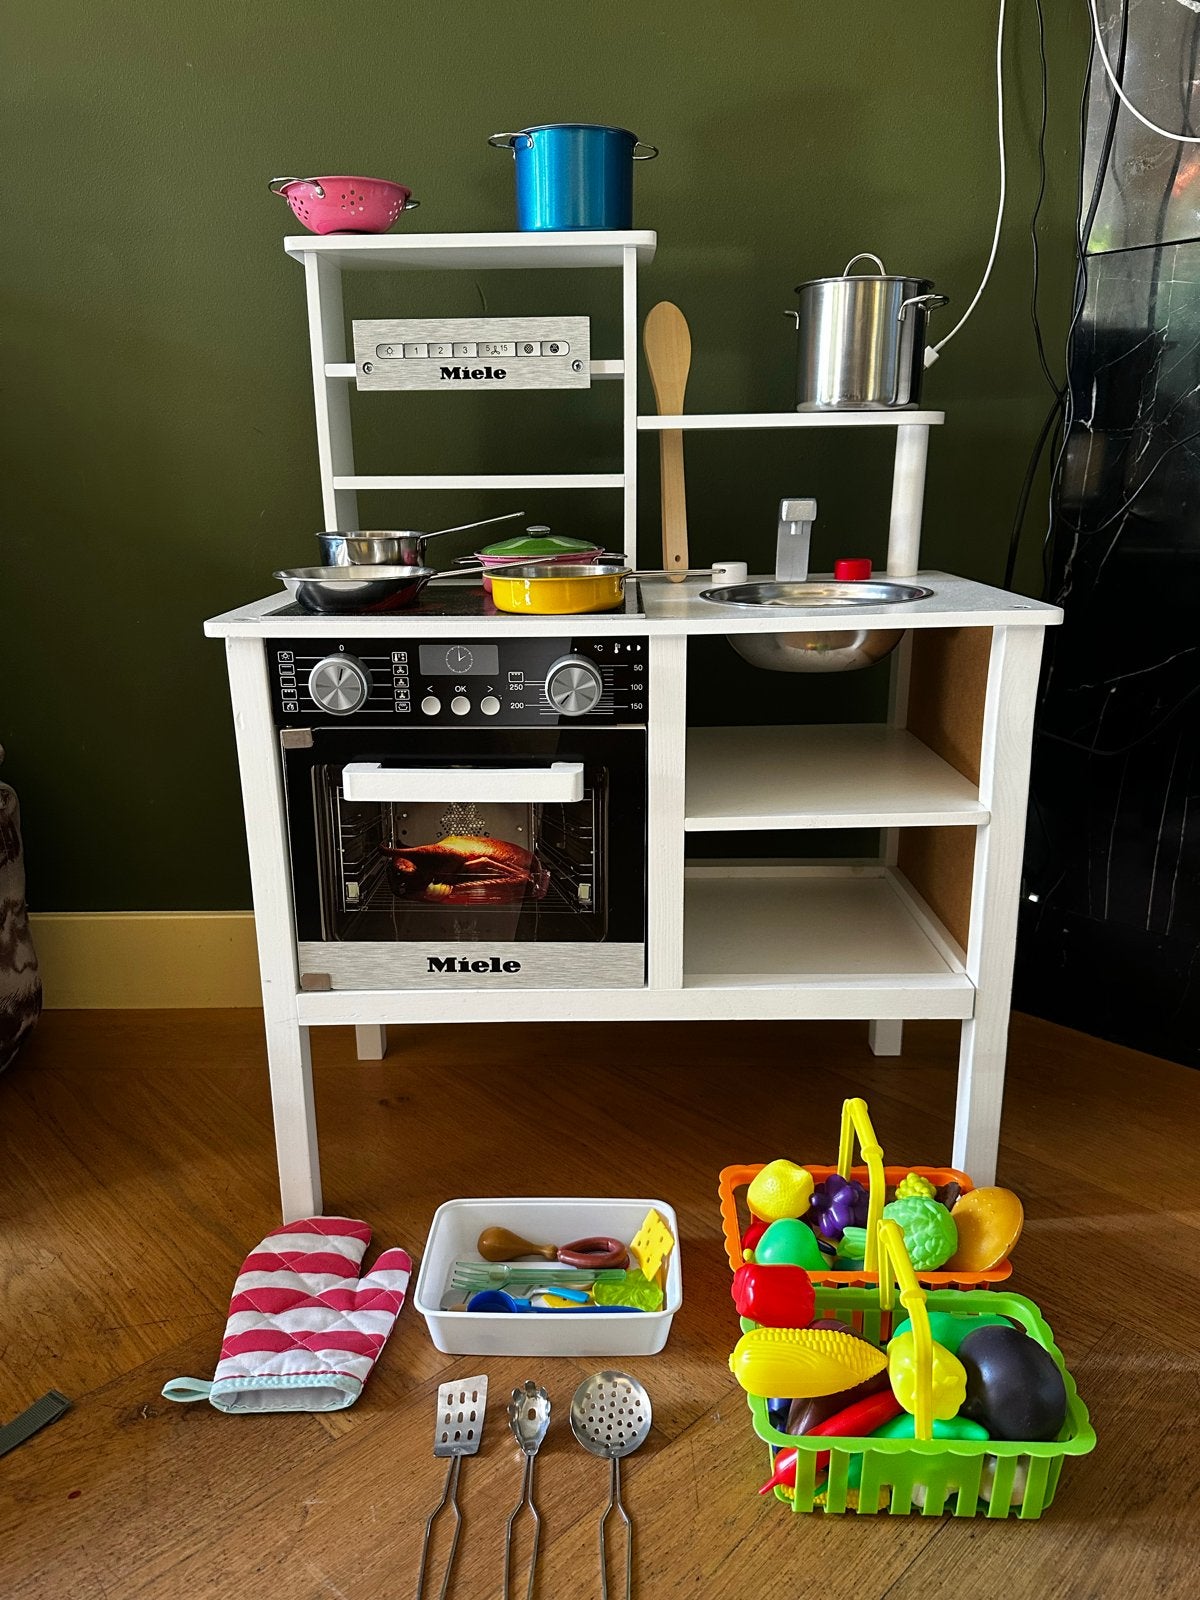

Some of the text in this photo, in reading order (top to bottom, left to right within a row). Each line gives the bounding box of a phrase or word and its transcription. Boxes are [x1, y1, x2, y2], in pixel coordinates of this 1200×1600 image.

[414, 347, 419, 355] 1
[438, 346, 444, 355] 2
[462, 346, 468, 354] 3
[485, 344, 508, 352] 5 15
[440, 366, 507, 380] Miele
[454, 685, 468, 693] OK
[509, 683, 524, 691] 250
[630, 702, 643, 710] 150
[427, 956, 521, 973] Miele
